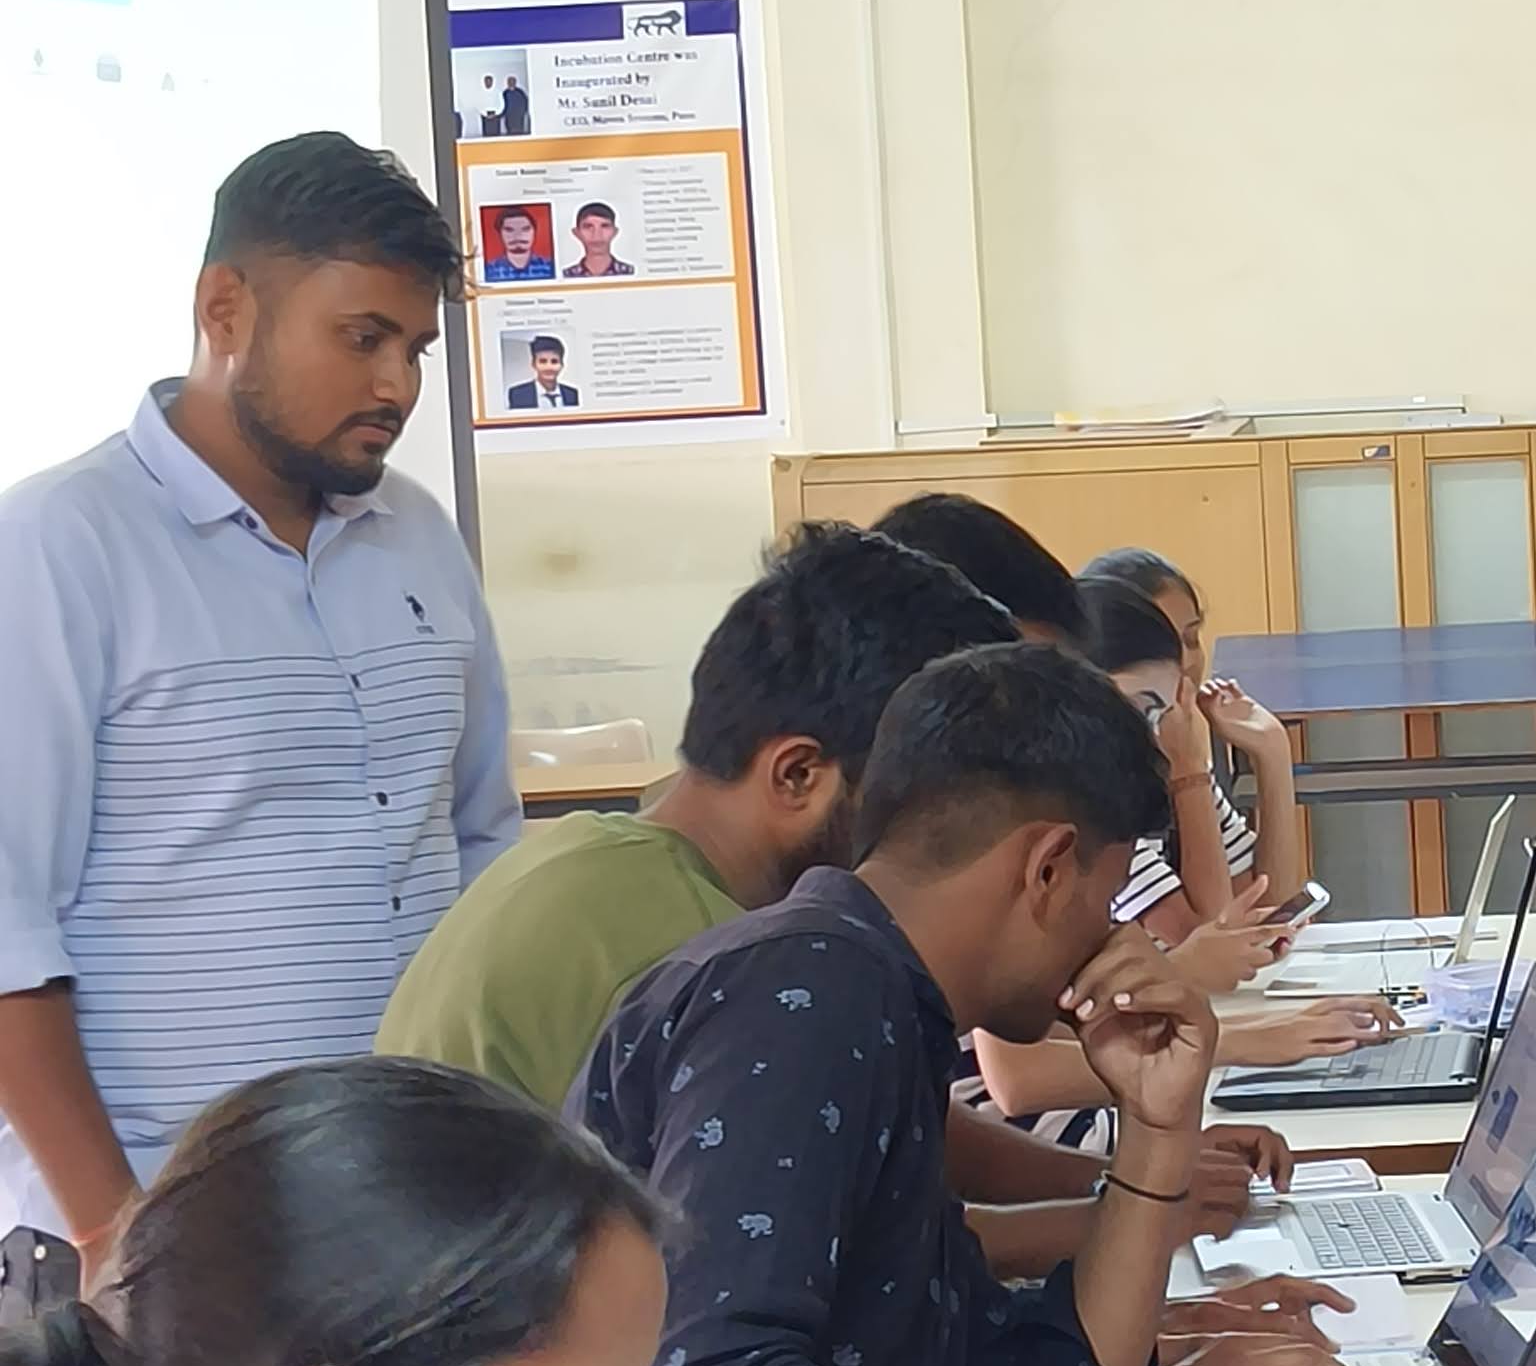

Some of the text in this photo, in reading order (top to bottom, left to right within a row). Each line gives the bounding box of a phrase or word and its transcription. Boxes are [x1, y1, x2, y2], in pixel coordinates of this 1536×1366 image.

[627, 52, 670, 63] Centre
[555, 72, 649, 88] Inaugurated by
